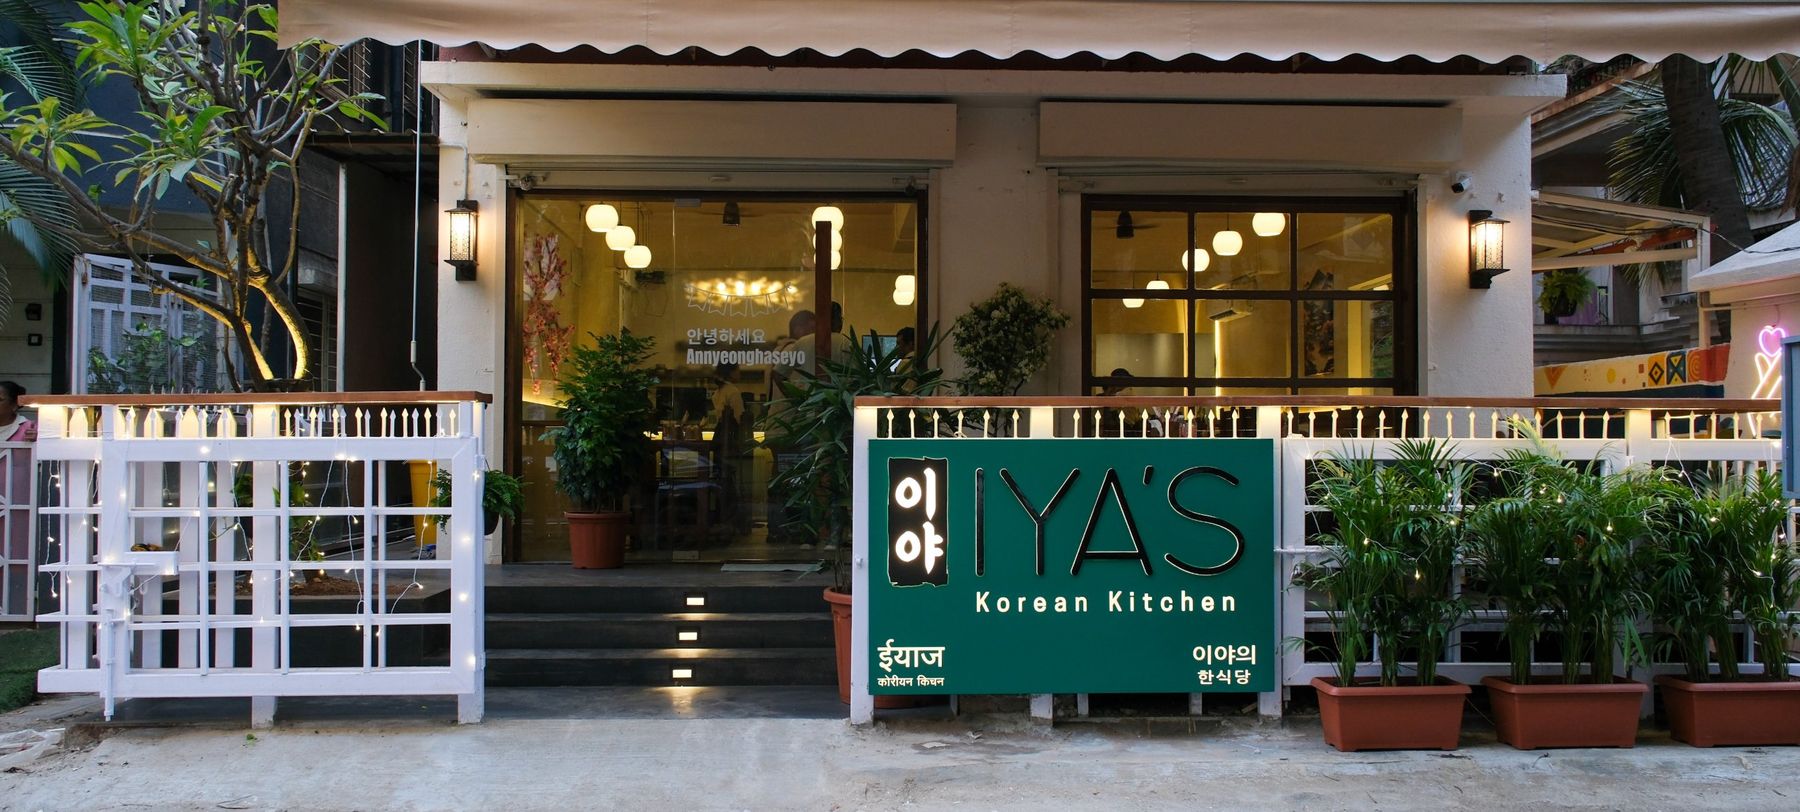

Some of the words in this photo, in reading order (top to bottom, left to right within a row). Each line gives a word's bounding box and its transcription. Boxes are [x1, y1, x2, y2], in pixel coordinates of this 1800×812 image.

[687, 328, 766, 345] 안녕하세요
[686, 348, 806, 366] Annyeonghaseyo
[895, 467, 944, 575] 이야
[975, 465, 1245, 576] IYA'S
[975, 591, 1088, 613] Korean
[1108, 590, 1236, 613] Kitchen
[877, 639, 946, 672] ईयाज
[1192, 644, 1256, 666] 이야의
[916, 674, 945, 687] किचन
[1197, 669, 1252, 685] 한식당
